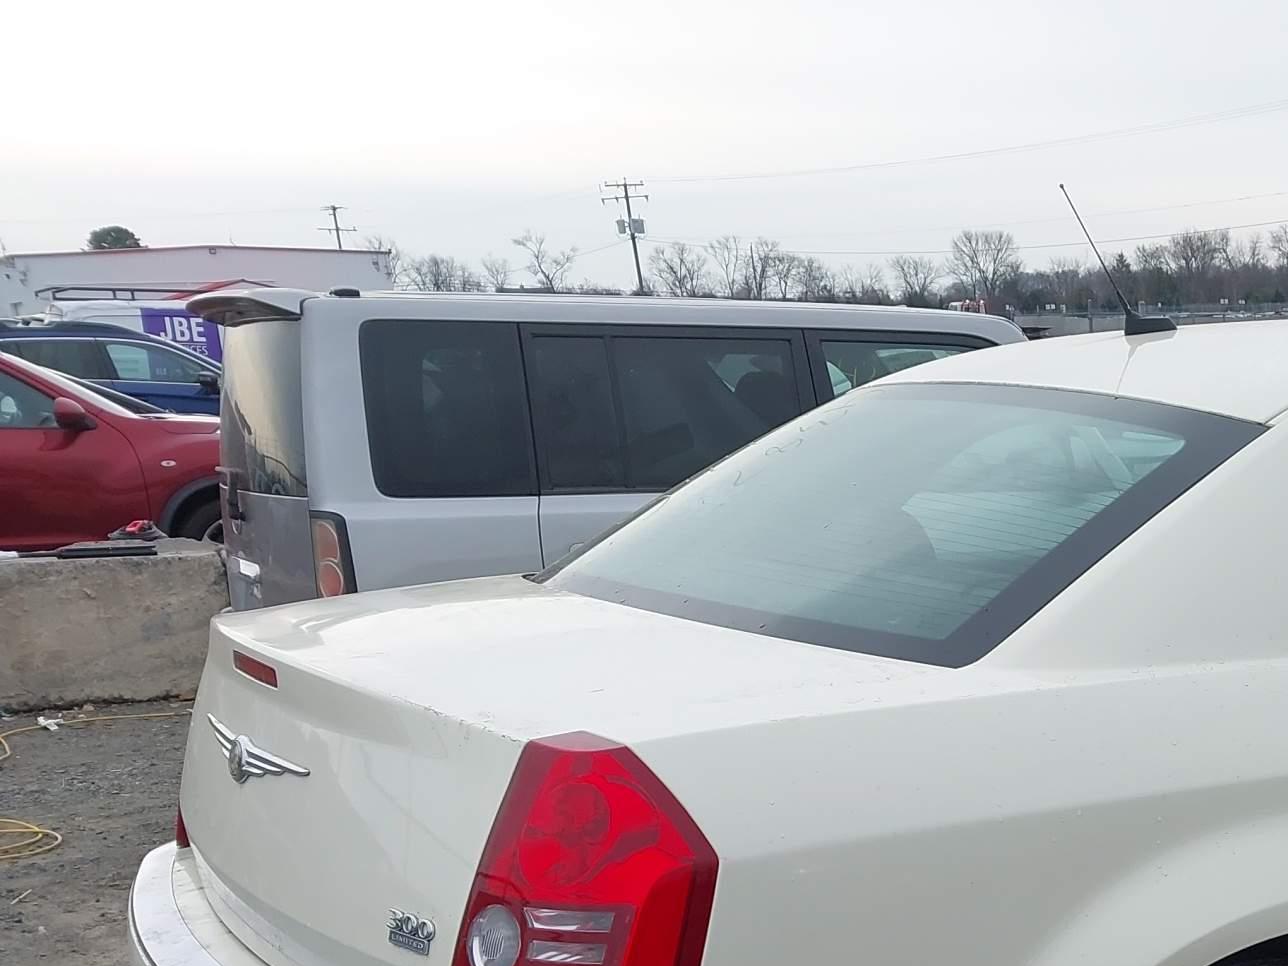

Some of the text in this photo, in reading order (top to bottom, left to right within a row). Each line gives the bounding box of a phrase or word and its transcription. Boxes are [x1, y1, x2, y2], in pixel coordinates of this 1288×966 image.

[160, 316, 207, 342] JBE
[385, 907, 436, 941] 300
[391, 932, 424, 949] LIMITED
